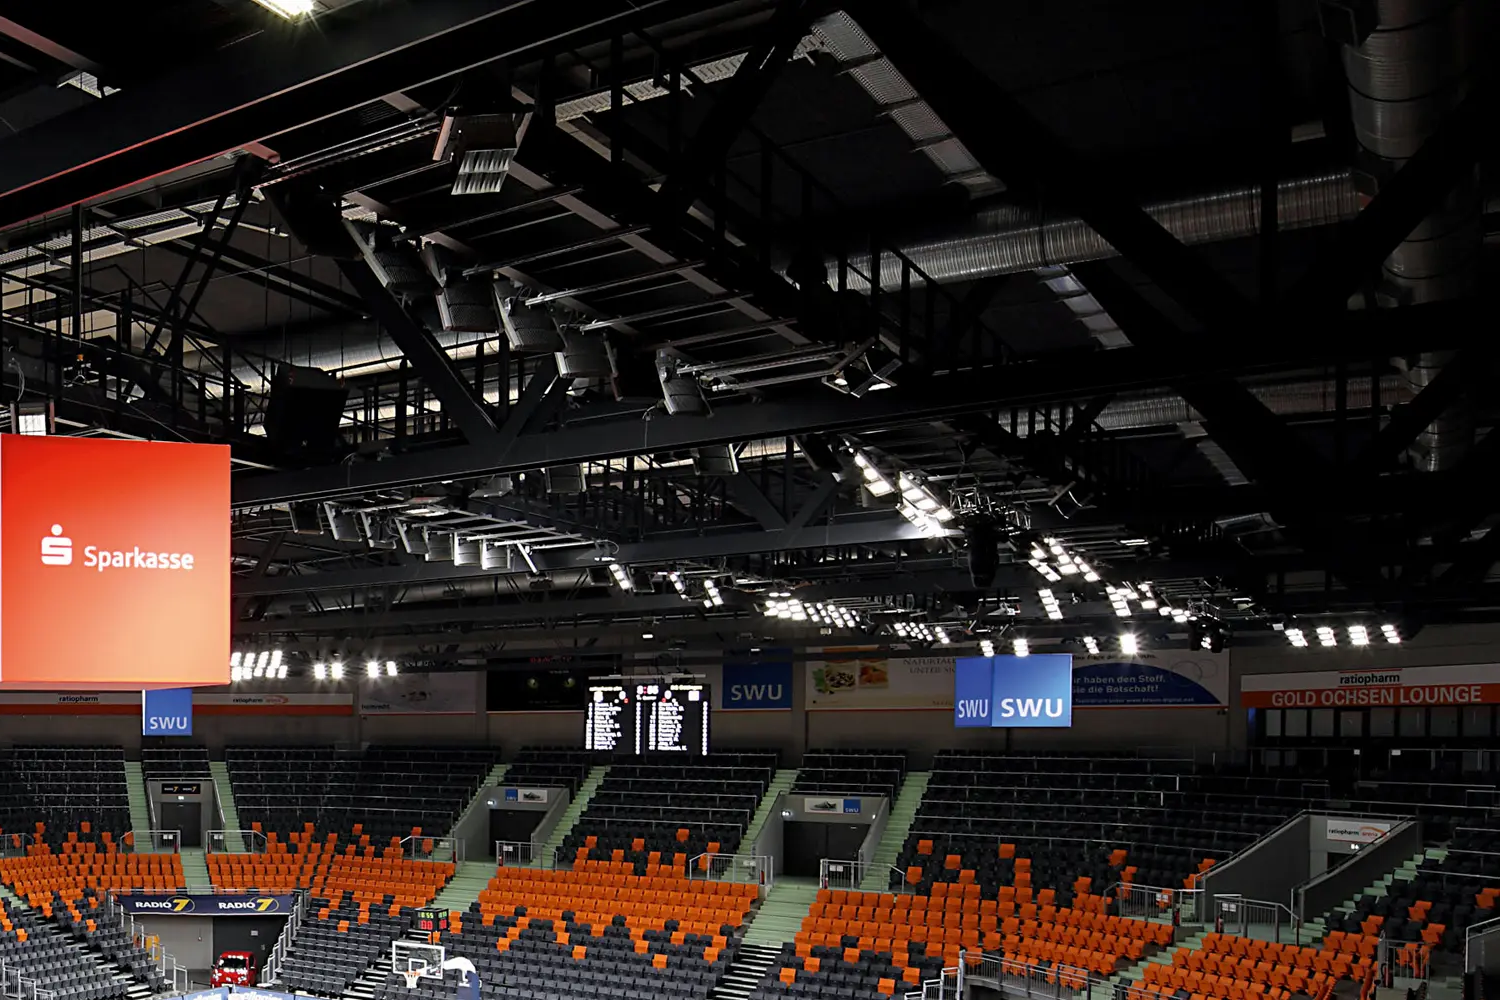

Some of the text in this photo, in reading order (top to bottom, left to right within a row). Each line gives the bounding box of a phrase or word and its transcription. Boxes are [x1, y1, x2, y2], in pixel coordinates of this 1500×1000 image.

[84, 546, 194, 572] Sparkasse
[1084, 675, 1113, 684] haben
[1117, 675, 1136, 684] den
[1340, 673, 1401, 687] ratiopharm
[58, 694, 99, 703] ratiopharm
[731, 683, 784, 701] SWU
[1271, 684, 1483, 707] GOLD OCHSEN LOUNGE
[957, 698, 990, 719] SWU
[1000, 697, 1064, 719] SWU
[149, 716, 188, 731] SWU
[135, 898, 190, 912] RADIO 7
[218, 898, 273, 912] RADIO 7
